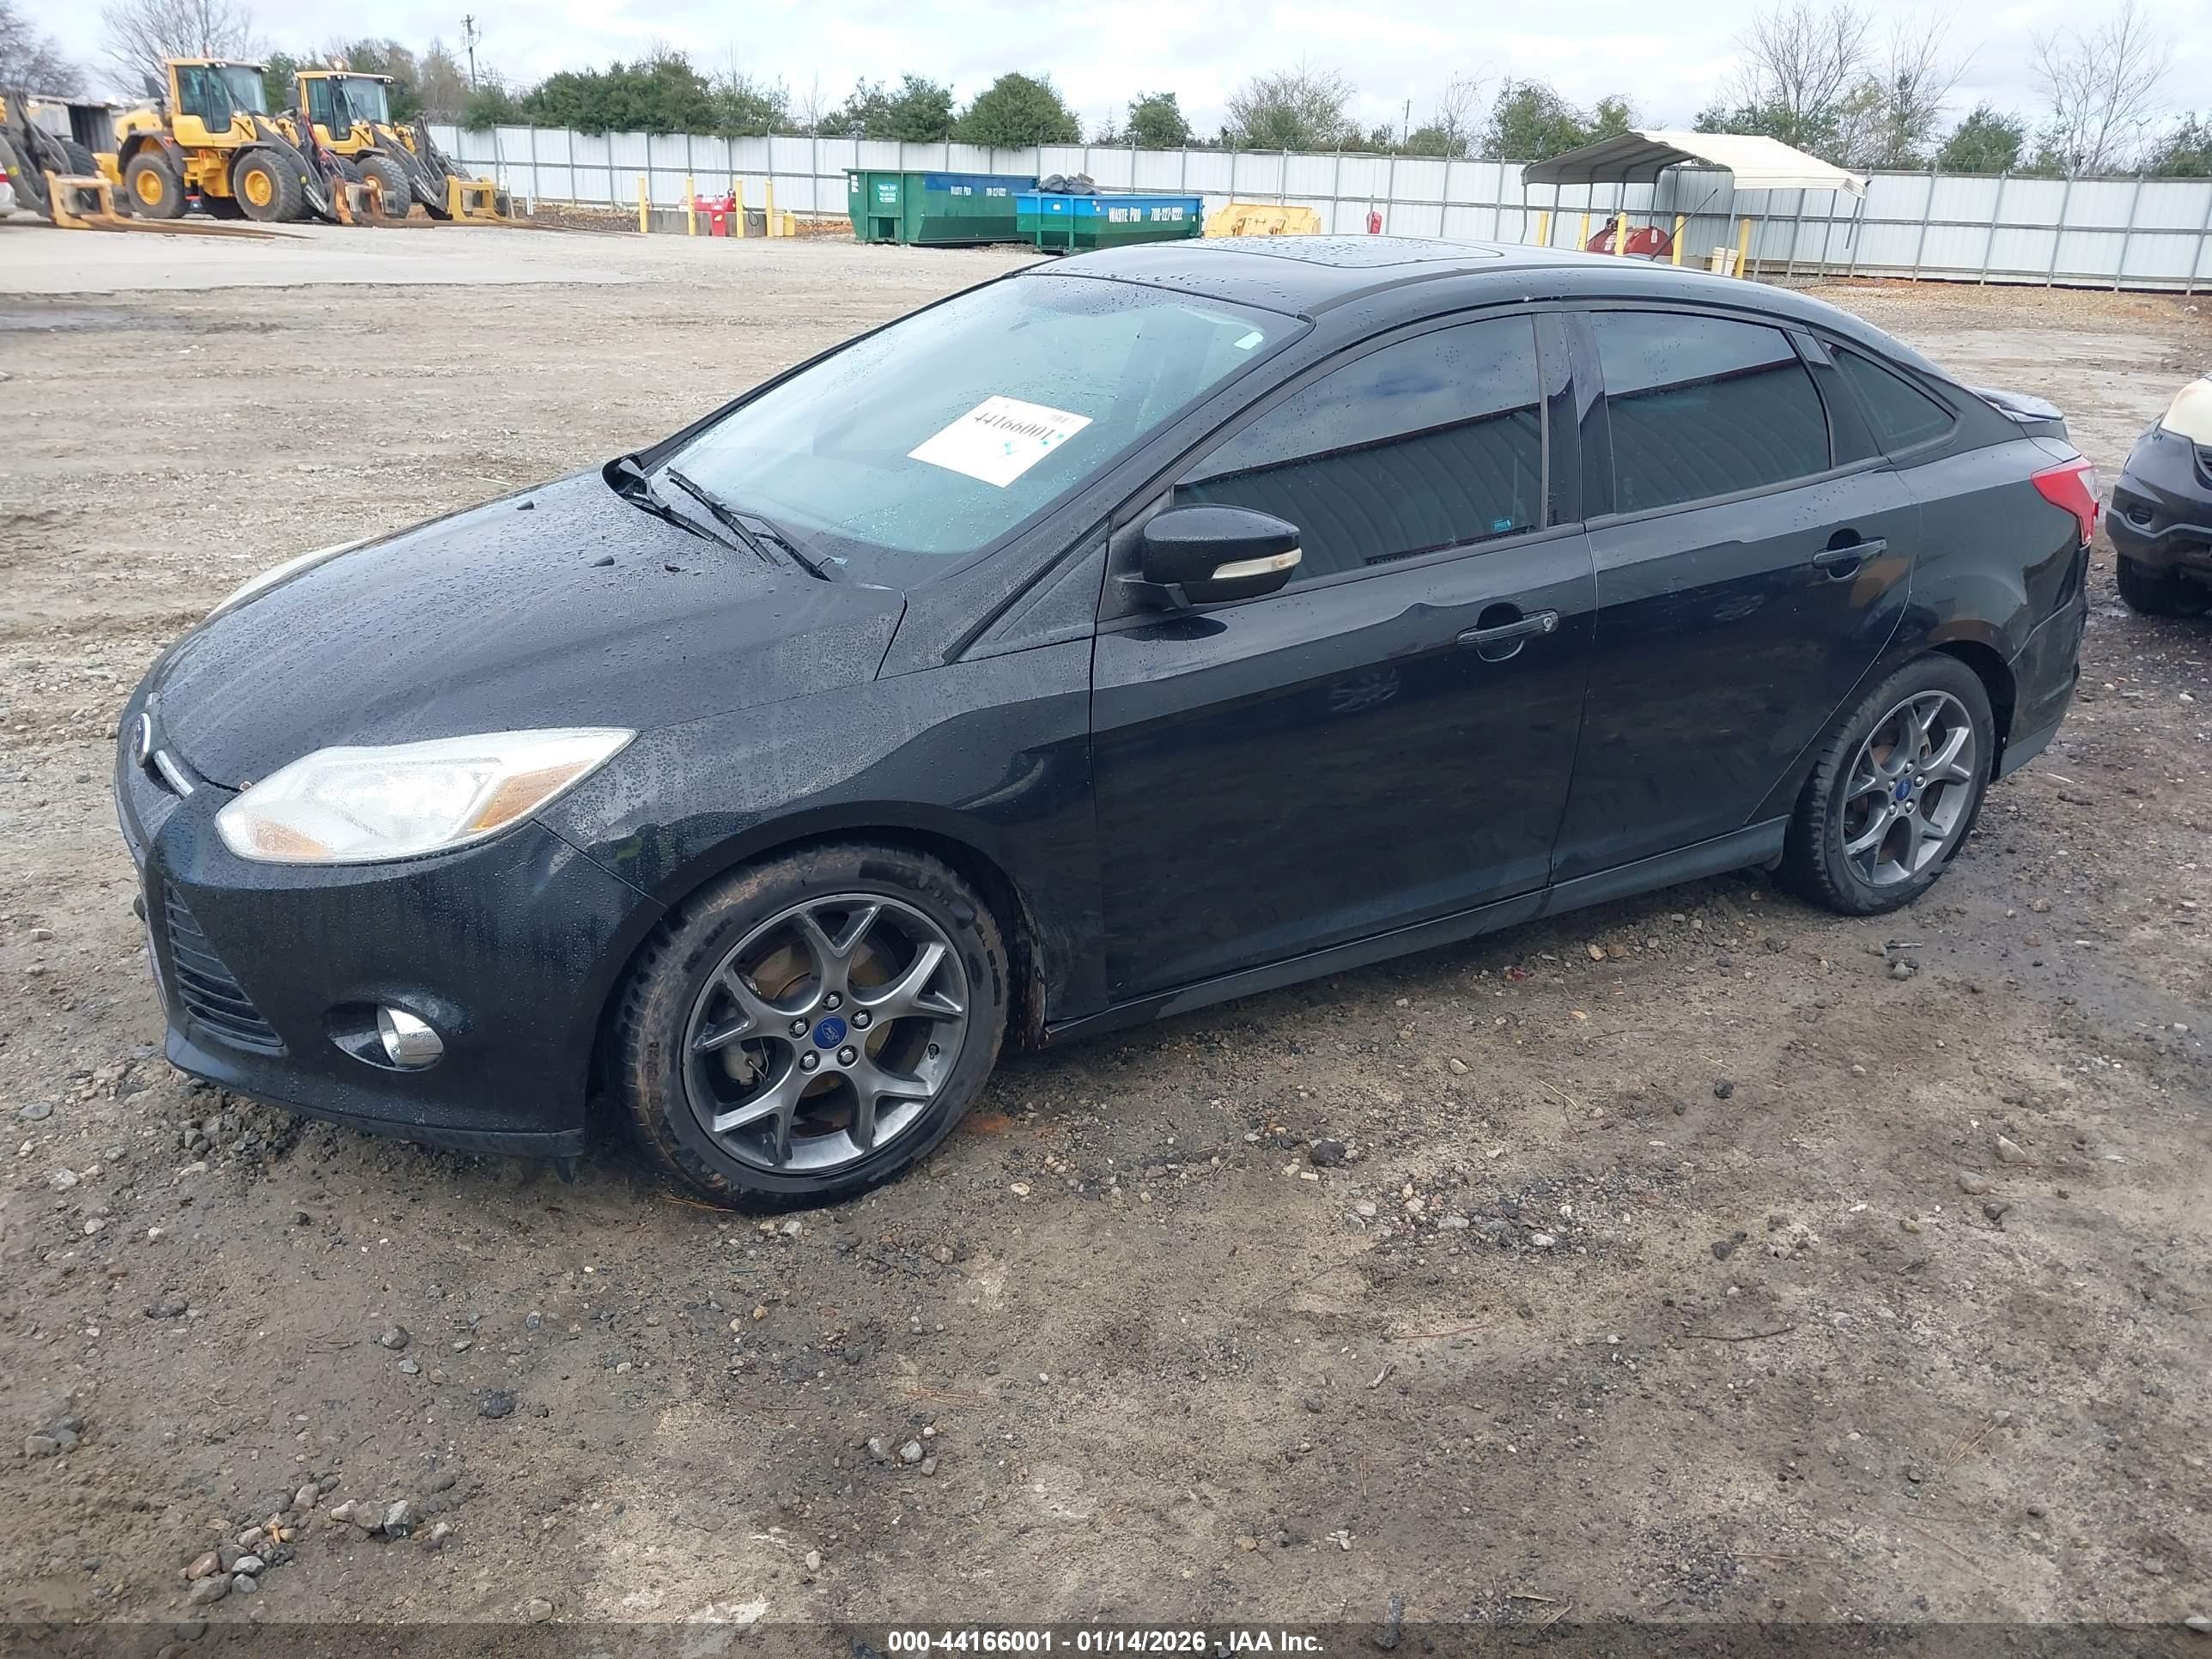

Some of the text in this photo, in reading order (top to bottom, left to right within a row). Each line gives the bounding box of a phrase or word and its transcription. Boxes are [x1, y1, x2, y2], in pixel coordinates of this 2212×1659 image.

[1109, 207, 1128, 222] WASTE
[1129, 207, 1141, 222] PRO
[975, 412, 1056, 441] 44166001
